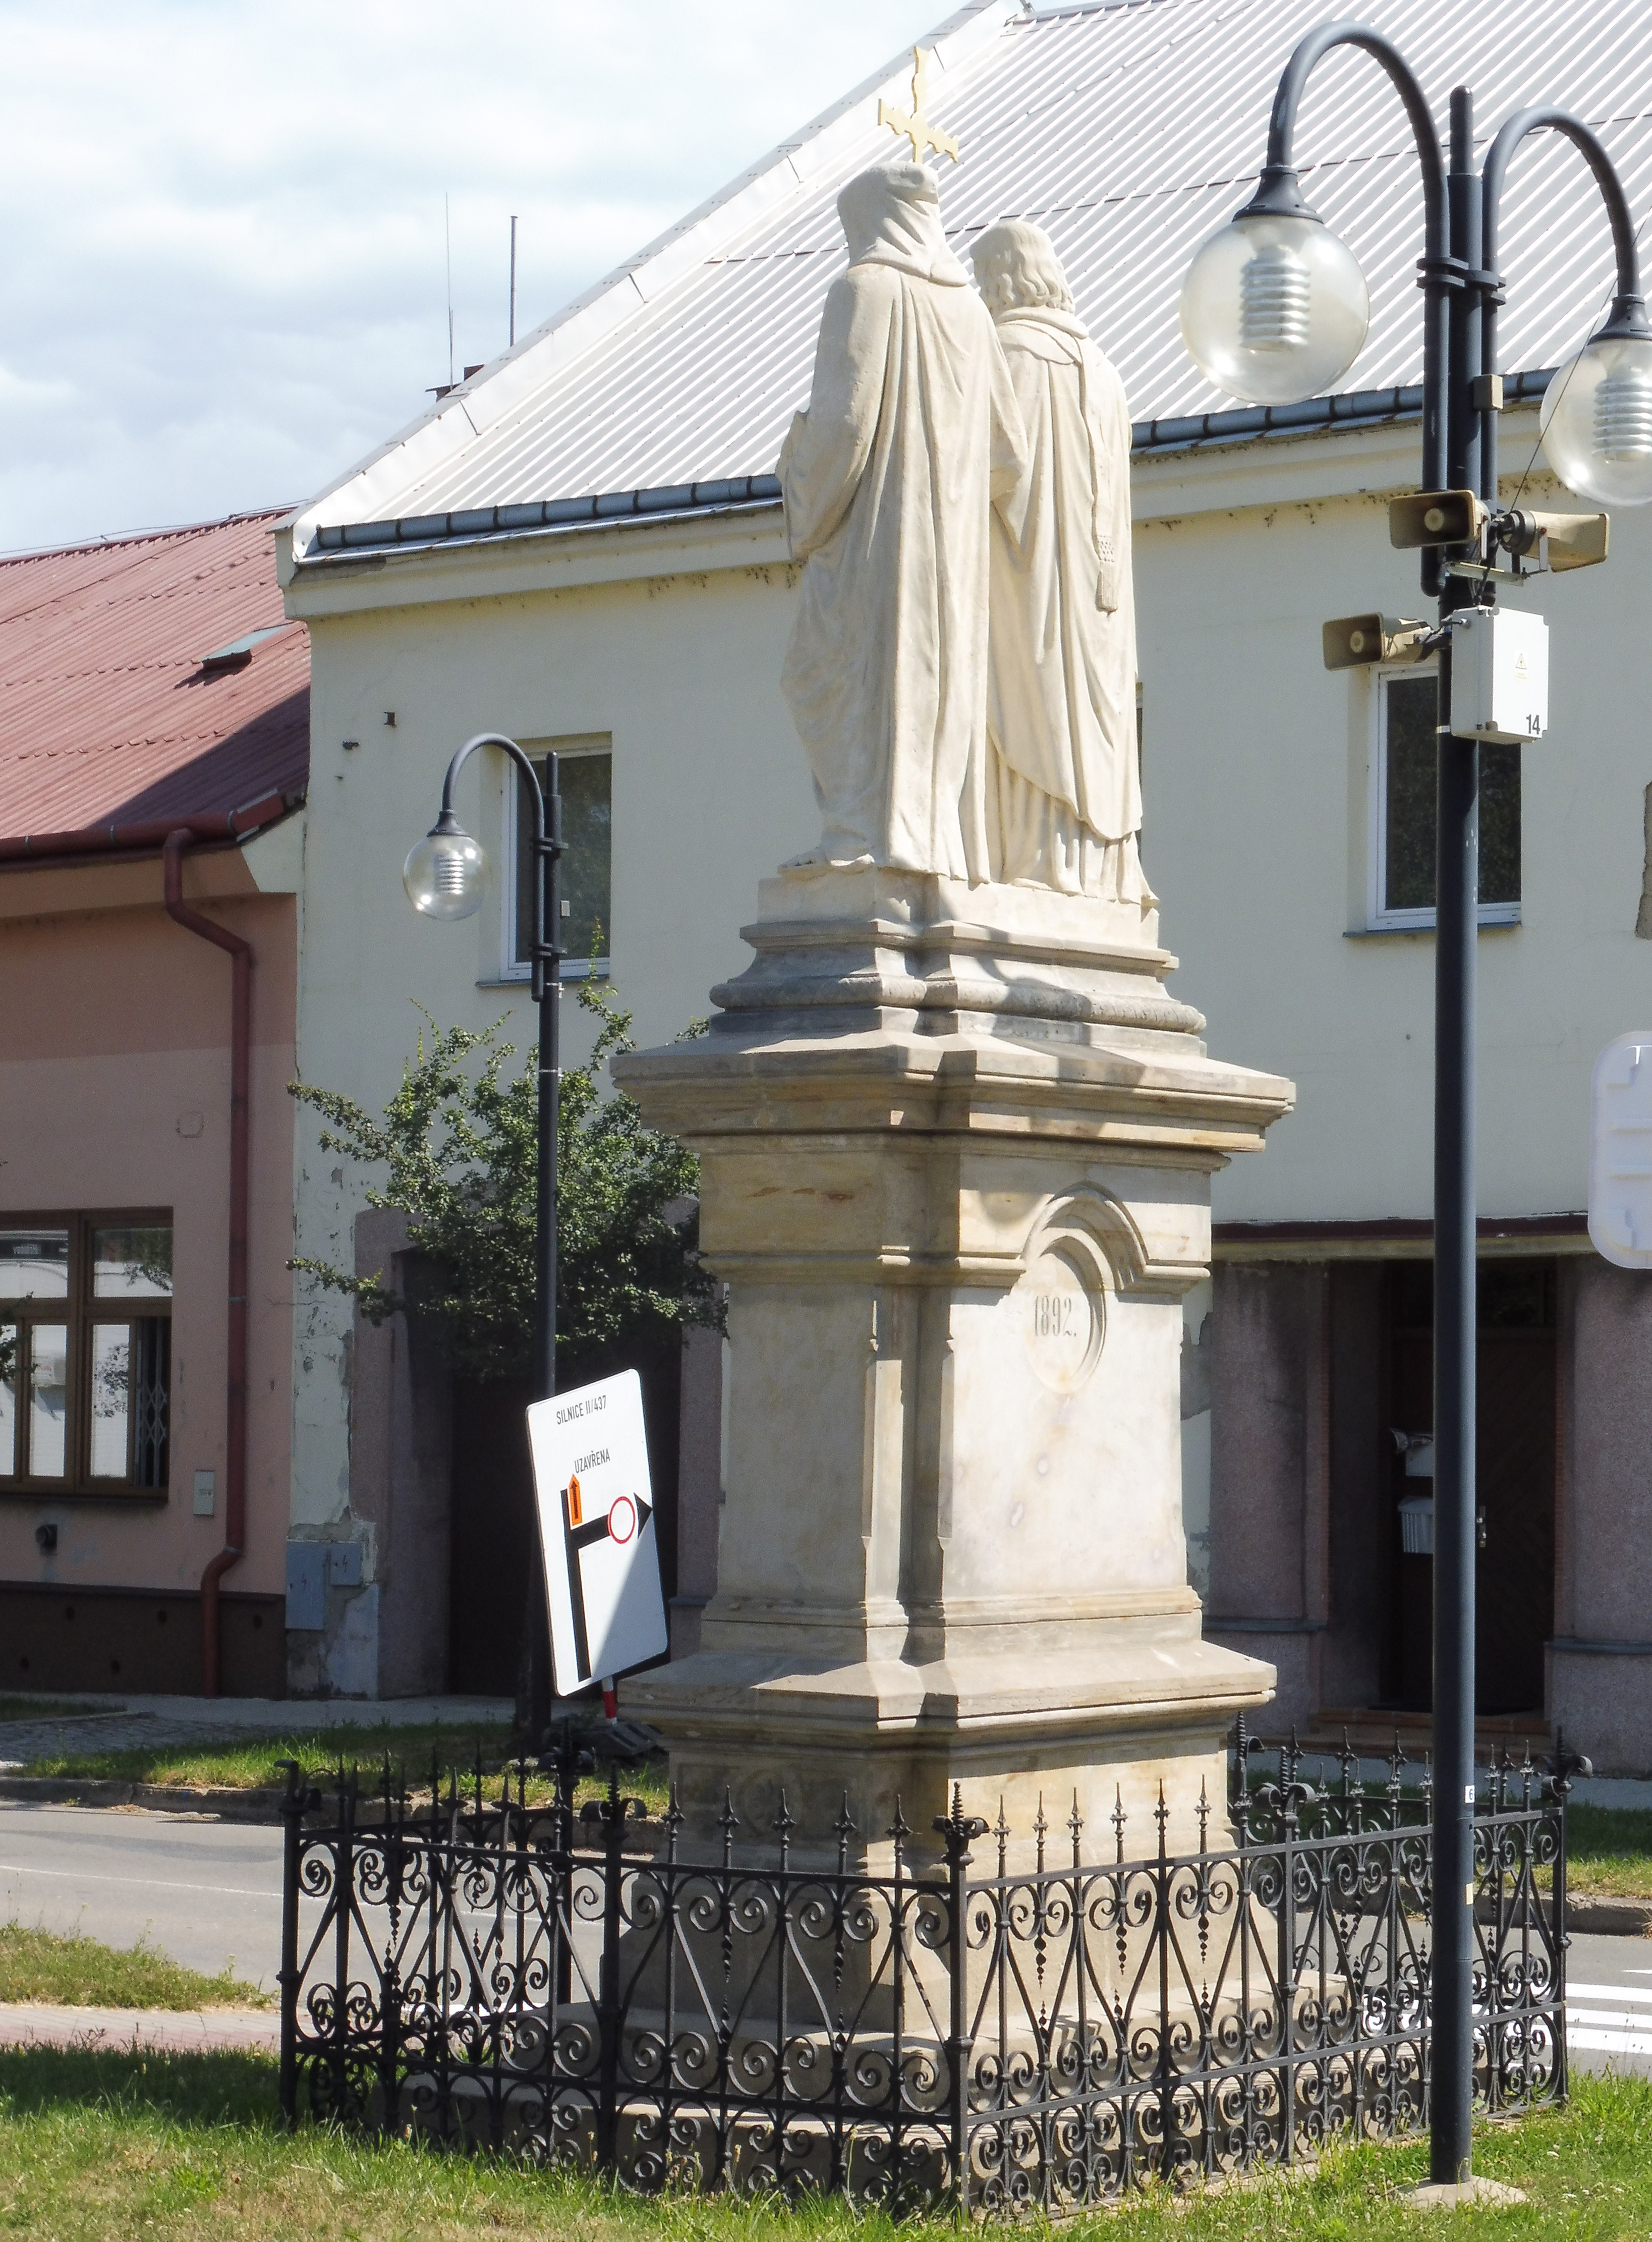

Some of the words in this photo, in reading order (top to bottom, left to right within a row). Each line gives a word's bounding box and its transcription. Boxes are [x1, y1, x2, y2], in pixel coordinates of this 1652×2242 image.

[1526, 714, 1540, 735] 14
[1035, 1296, 1076, 1337] 1892.
[556, 1403, 584, 1425] SILNICE
[586, 1395, 606, 1414] II/437
[574, 1448, 610, 1474] UZAVŘENA
[1469, 1788, 1473, 1800] 6
